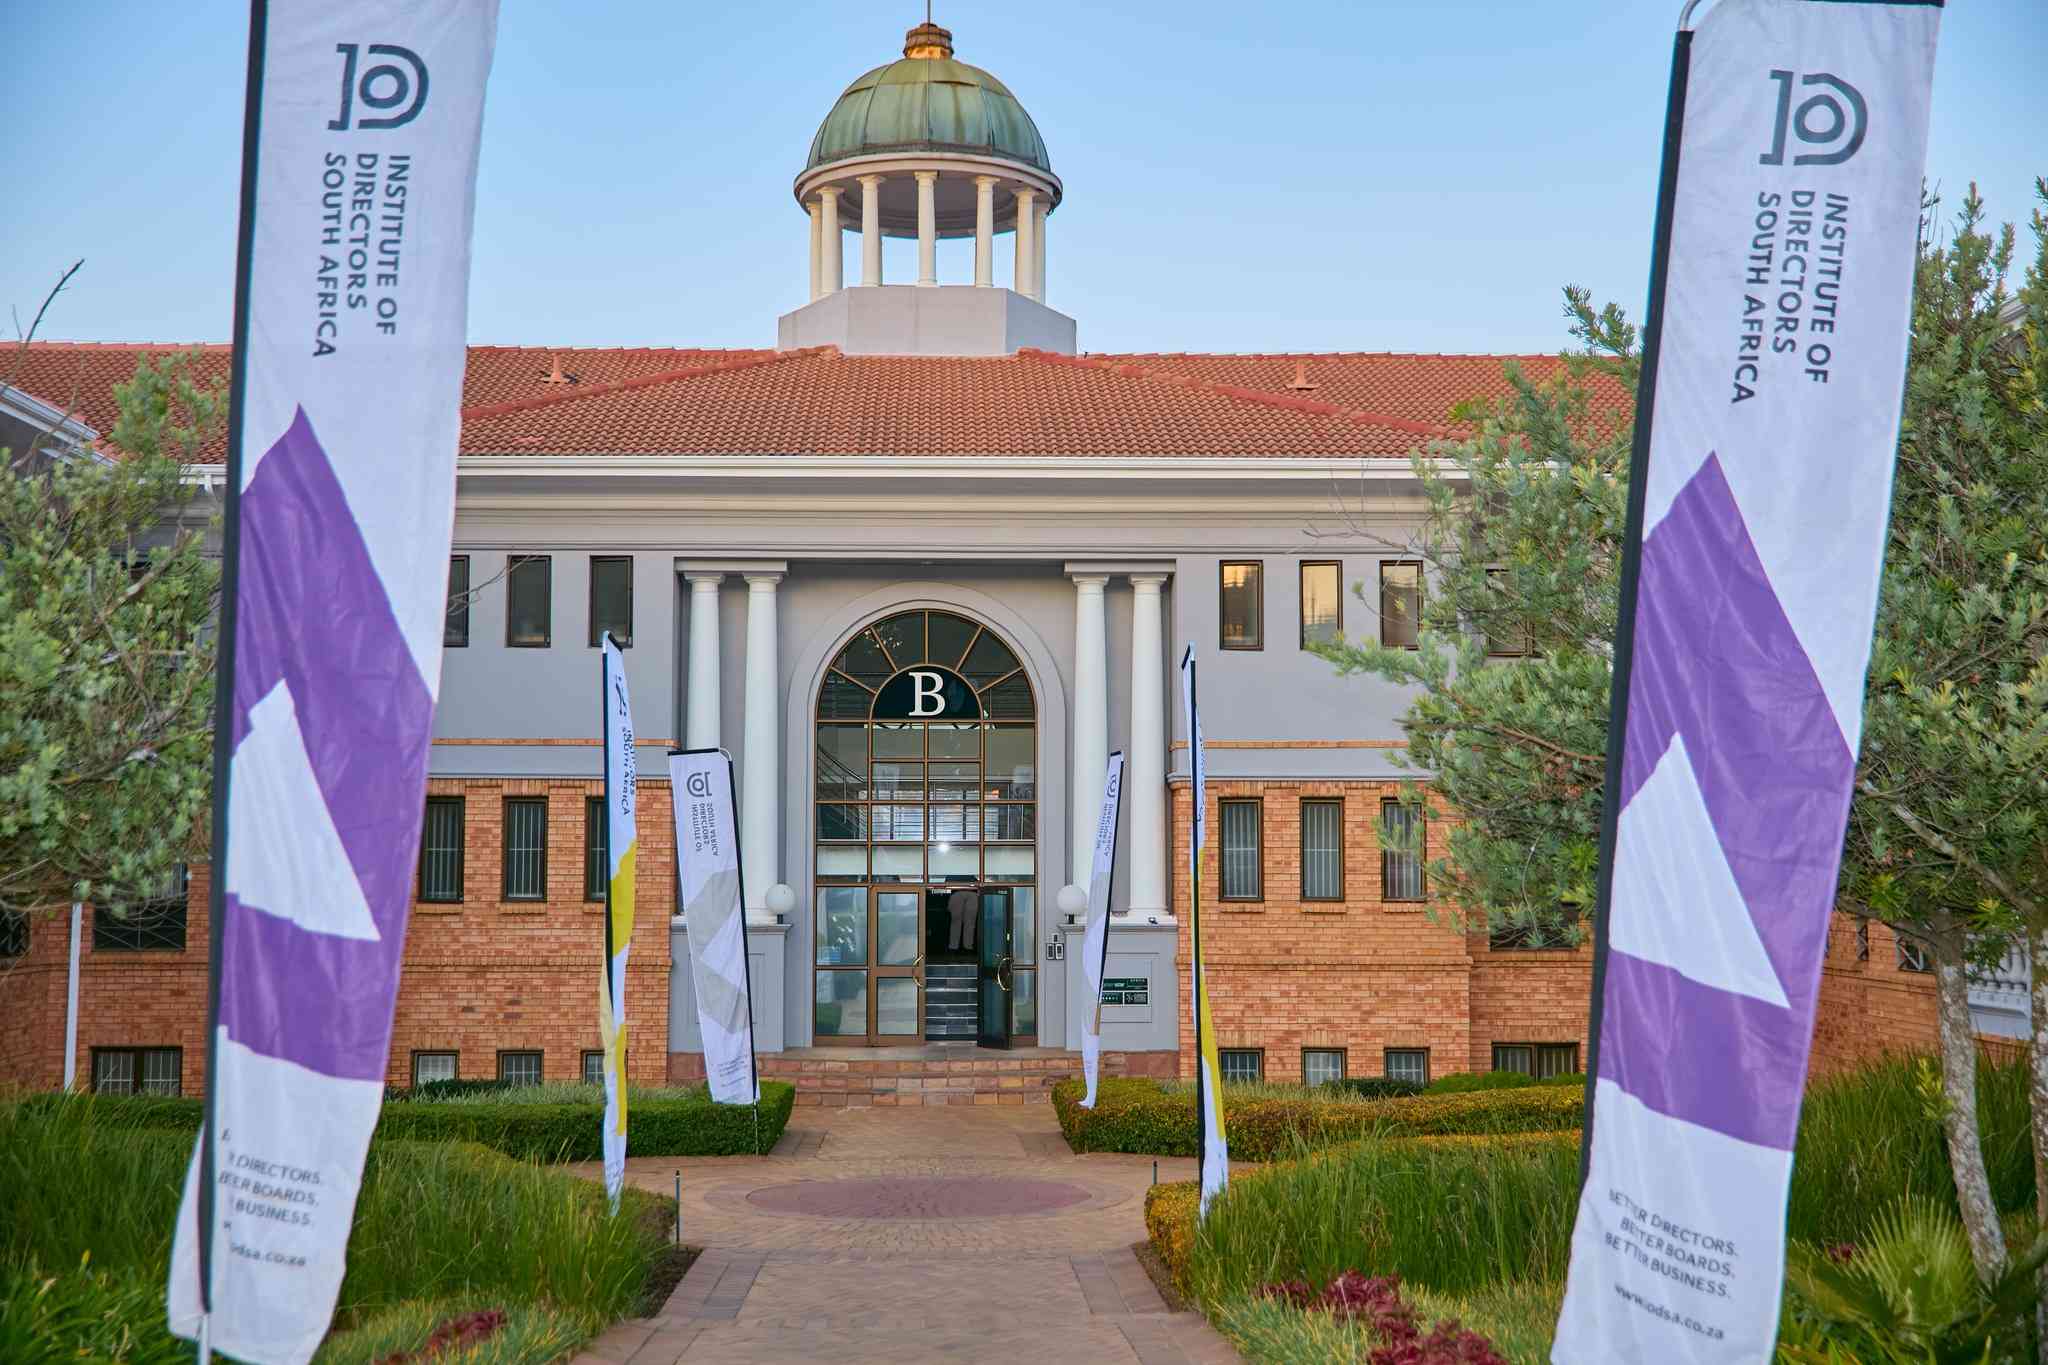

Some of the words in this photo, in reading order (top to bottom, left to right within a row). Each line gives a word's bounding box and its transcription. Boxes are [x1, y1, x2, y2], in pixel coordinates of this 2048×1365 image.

[321, 152, 347, 245] SOUTH
[346, 153, 378, 310] DIRECTORS
[376, 154, 410, 287] INSTITUTE
[1746, 191, 1781, 285] SOUTH
[313, 255, 340, 357] AFRICA
[1771, 190, 1816, 354] DIRECTORS
[1810, 192, 1848, 334] INSTITUTE
[376, 297, 397, 335] OF
[1731, 294, 1766, 405] AFRICA
[1804, 344, 1831, 384] OF
[908, 671, 946, 717] B
[1650, 1213, 1738, 1257] DRECTORS.
